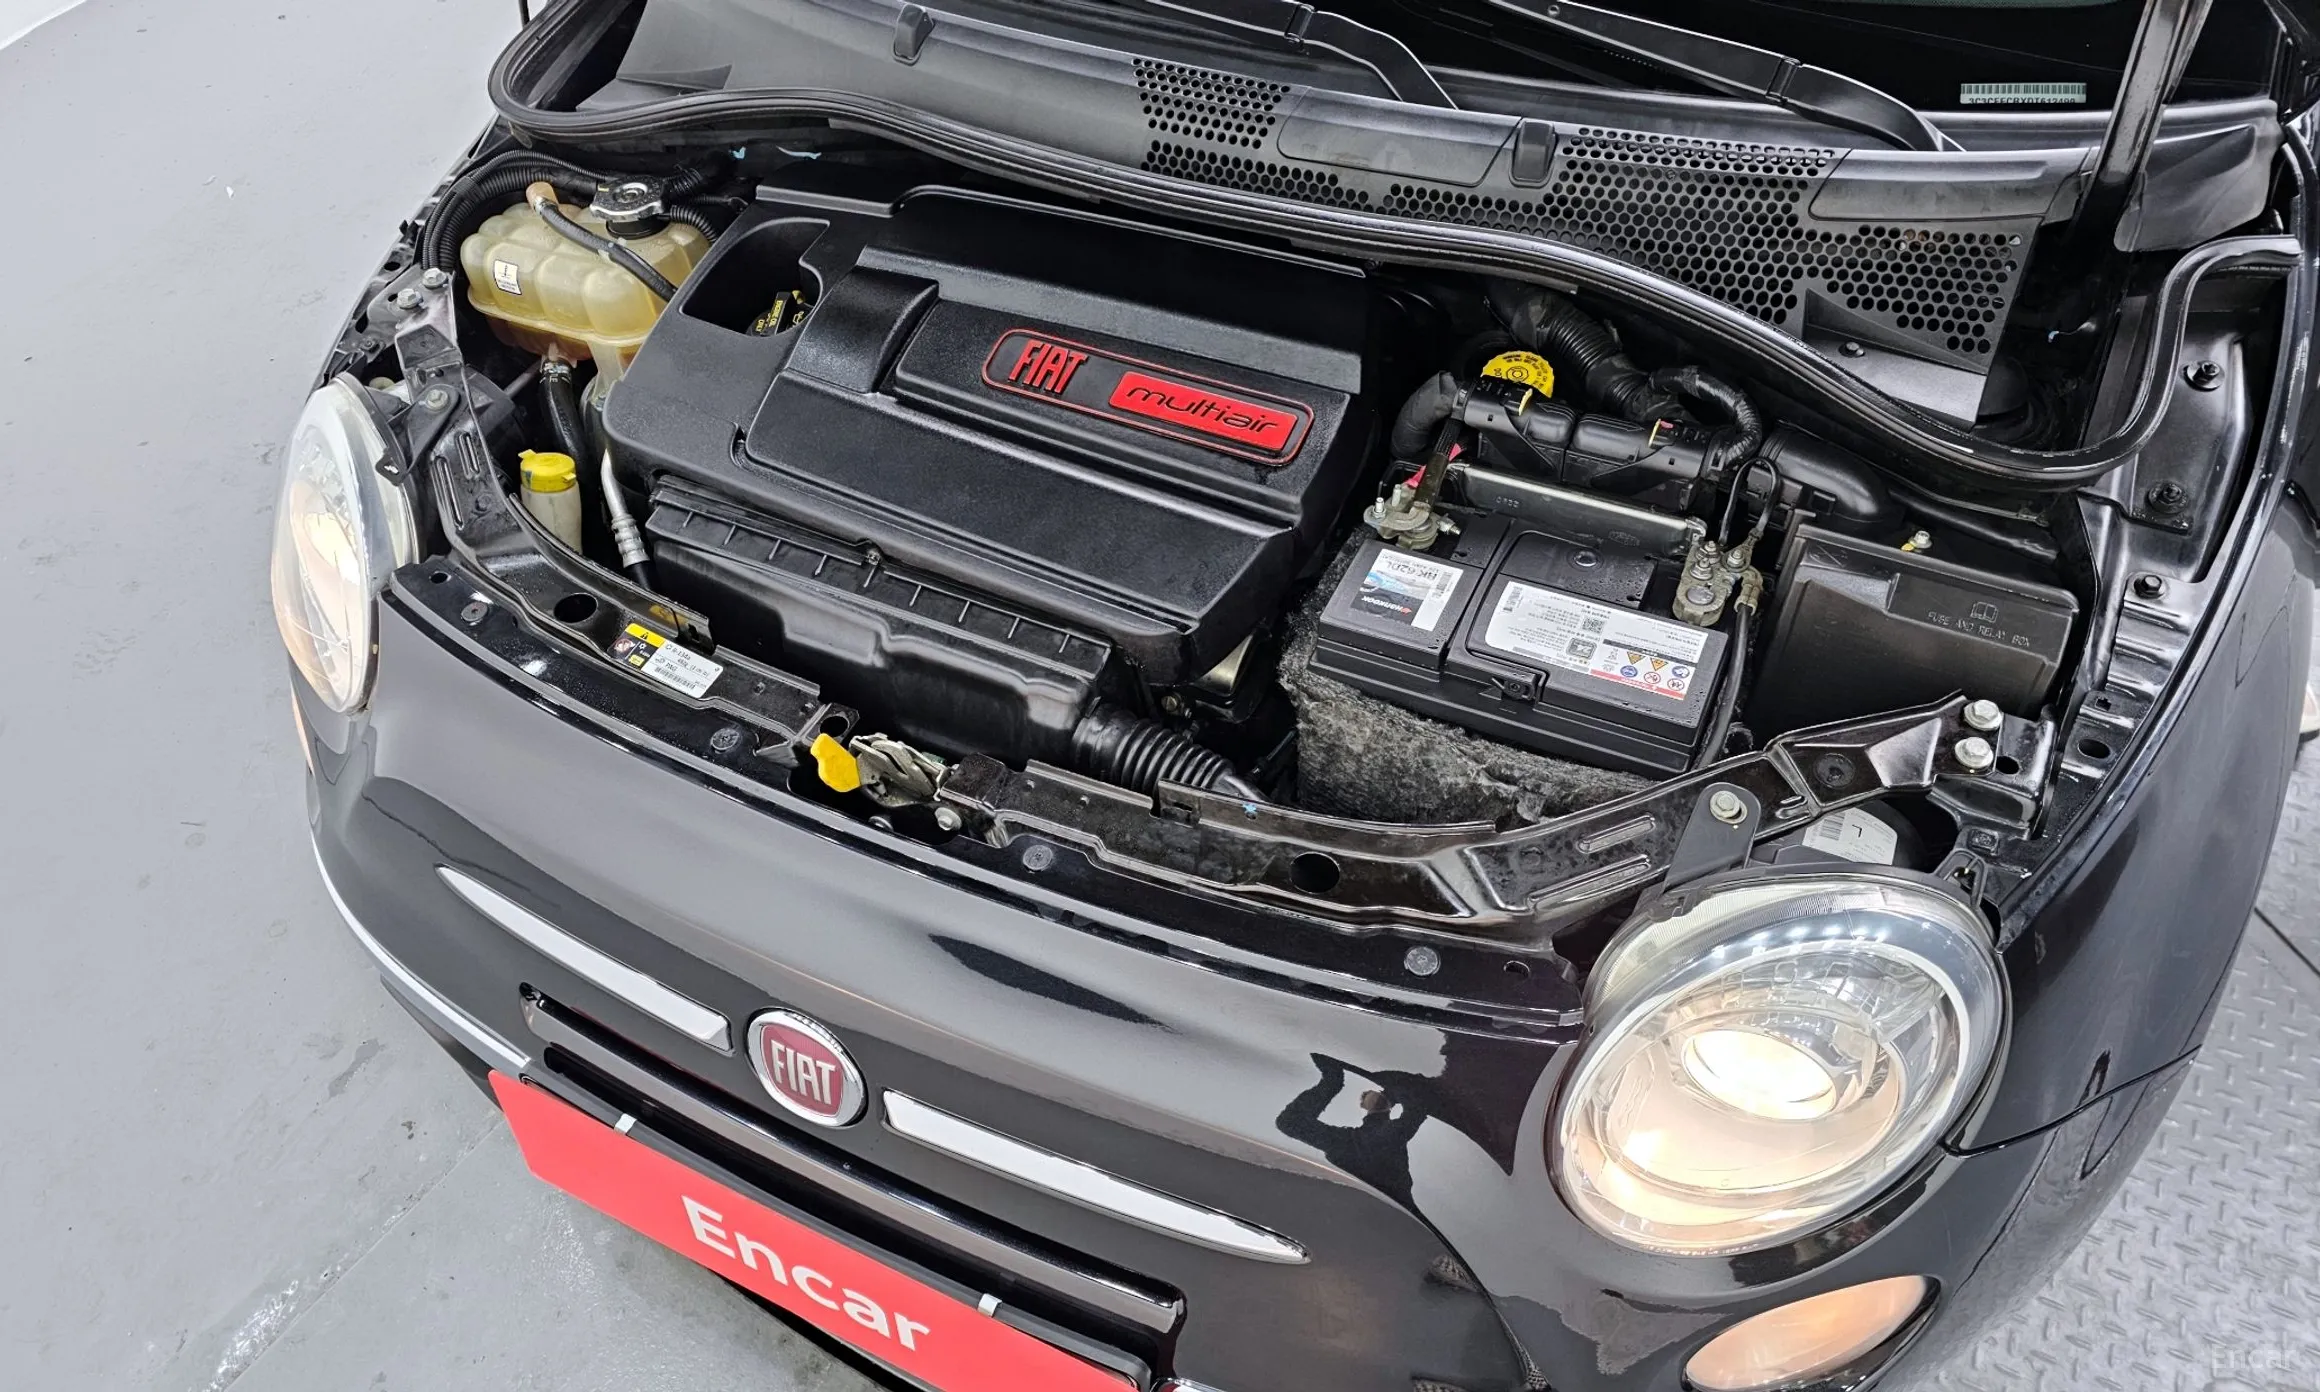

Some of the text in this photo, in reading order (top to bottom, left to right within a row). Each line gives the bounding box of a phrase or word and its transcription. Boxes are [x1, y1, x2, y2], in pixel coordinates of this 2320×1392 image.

[1008, 339, 1279, 434] FIAT multiair
[1928, 611, 2030, 647] FUSE AND RELAY BOX
[771, 1039, 836, 1105] FIAT
[681, 1195, 931, 1351] Encar
